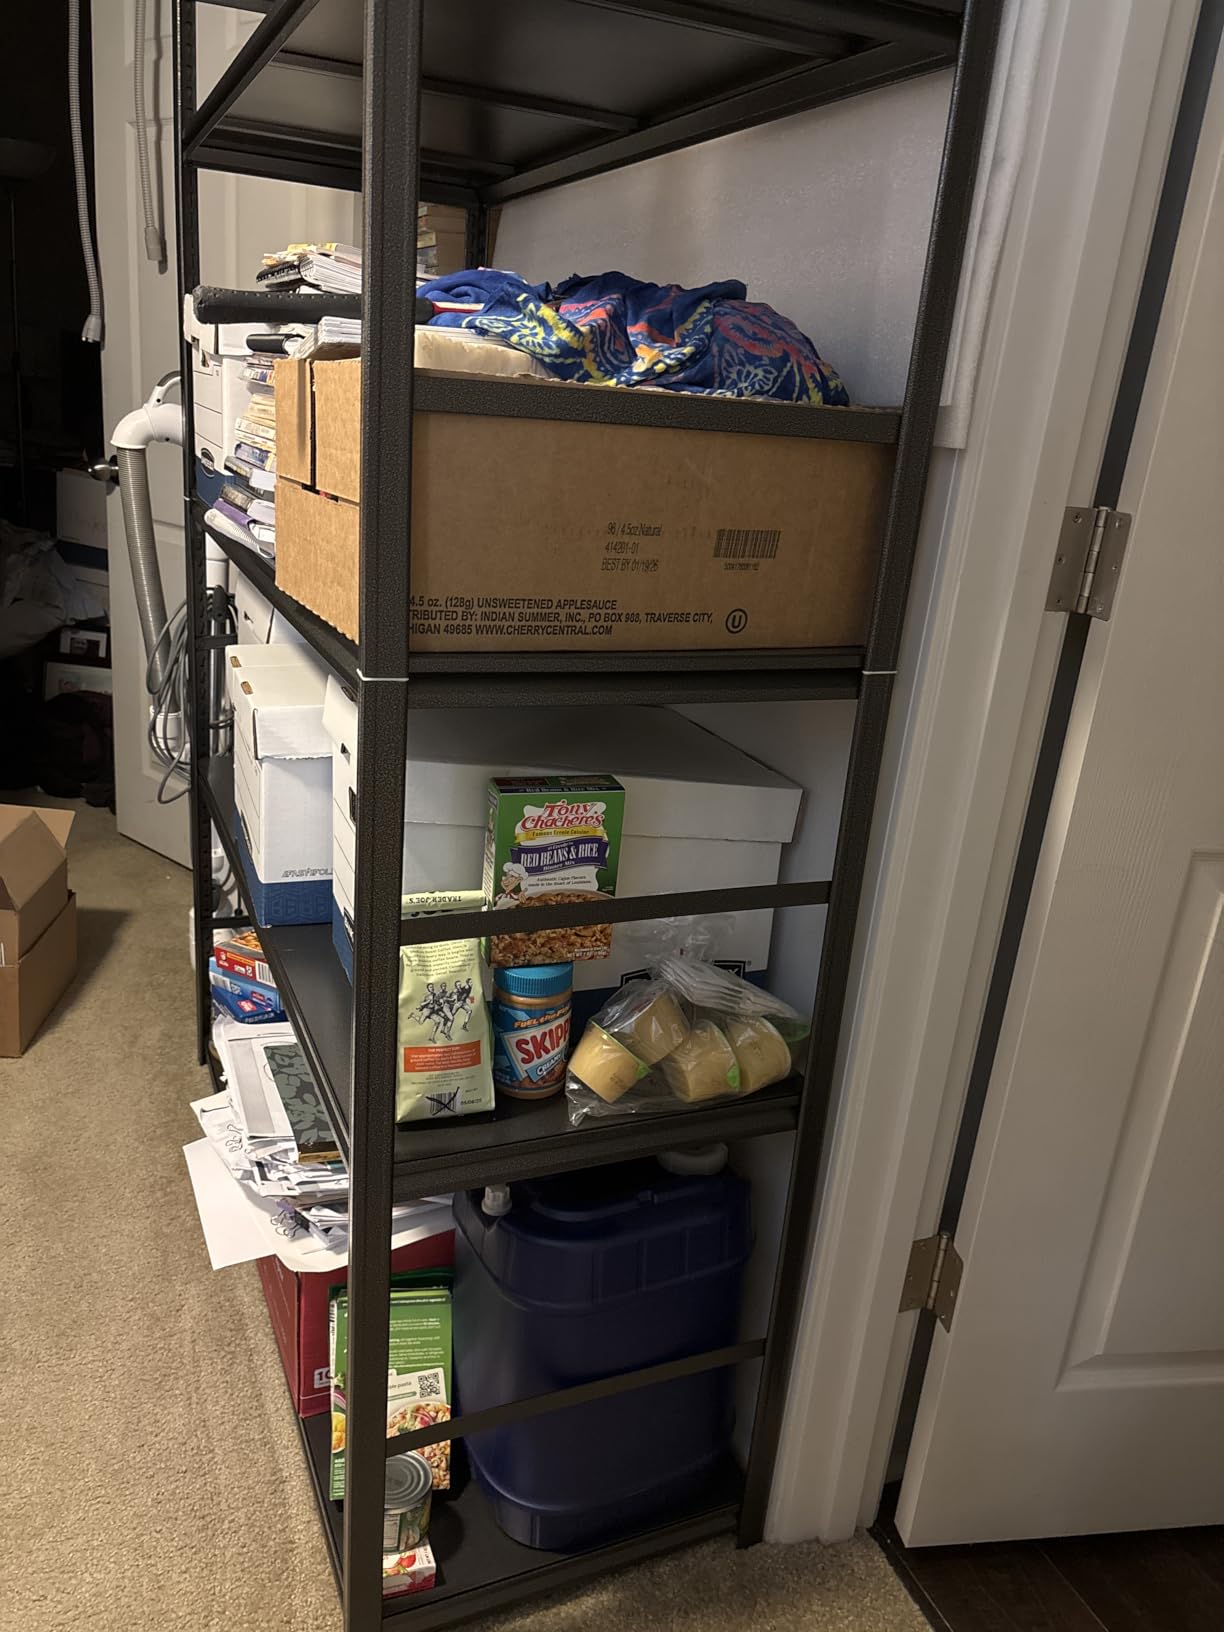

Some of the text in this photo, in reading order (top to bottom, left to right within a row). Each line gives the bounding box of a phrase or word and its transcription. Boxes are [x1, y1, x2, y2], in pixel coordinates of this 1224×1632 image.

[607, 522, 616, 535] 96
[601, 558, 620, 571] BEST
[620, 558, 632, 571] BY
[427, 598, 442, 608] oz.
[445, 596, 474, 610] (128g)
[477, 597, 553, 609] UNSWEETENED
[555, 599, 617, 610] APPLESAUCE
[461, 610, 478, 621] BY:
[480, 611, 515, 622] INDIAN
[517, 611, 562, 624] SUMMER,
[565, 612, 586, 624] INC.,
[588, 612, 601, 623] PO
[603, 612, 623, 623] BOX
[624, 612, 642, 625] 988,
[644, 612, 691, 624] TRAVERSE
[692, 612, 713, 625] CITY,
[443, 624, 473, 635] 49685
[475, 624, 612, 636] WWW.CHERRYCENTRAL.COM
[543, 801, 597, 818] Tony
[521, 852, 540, 868] RED
[540, 846, 569, 866] BEANS
[569, 845, 577, 859] &
[578, 842, 599, 858] RICE
[409, 895, 462, 904] TRADER JOE'S
[514, 1018, 539, 1029] FUEL
